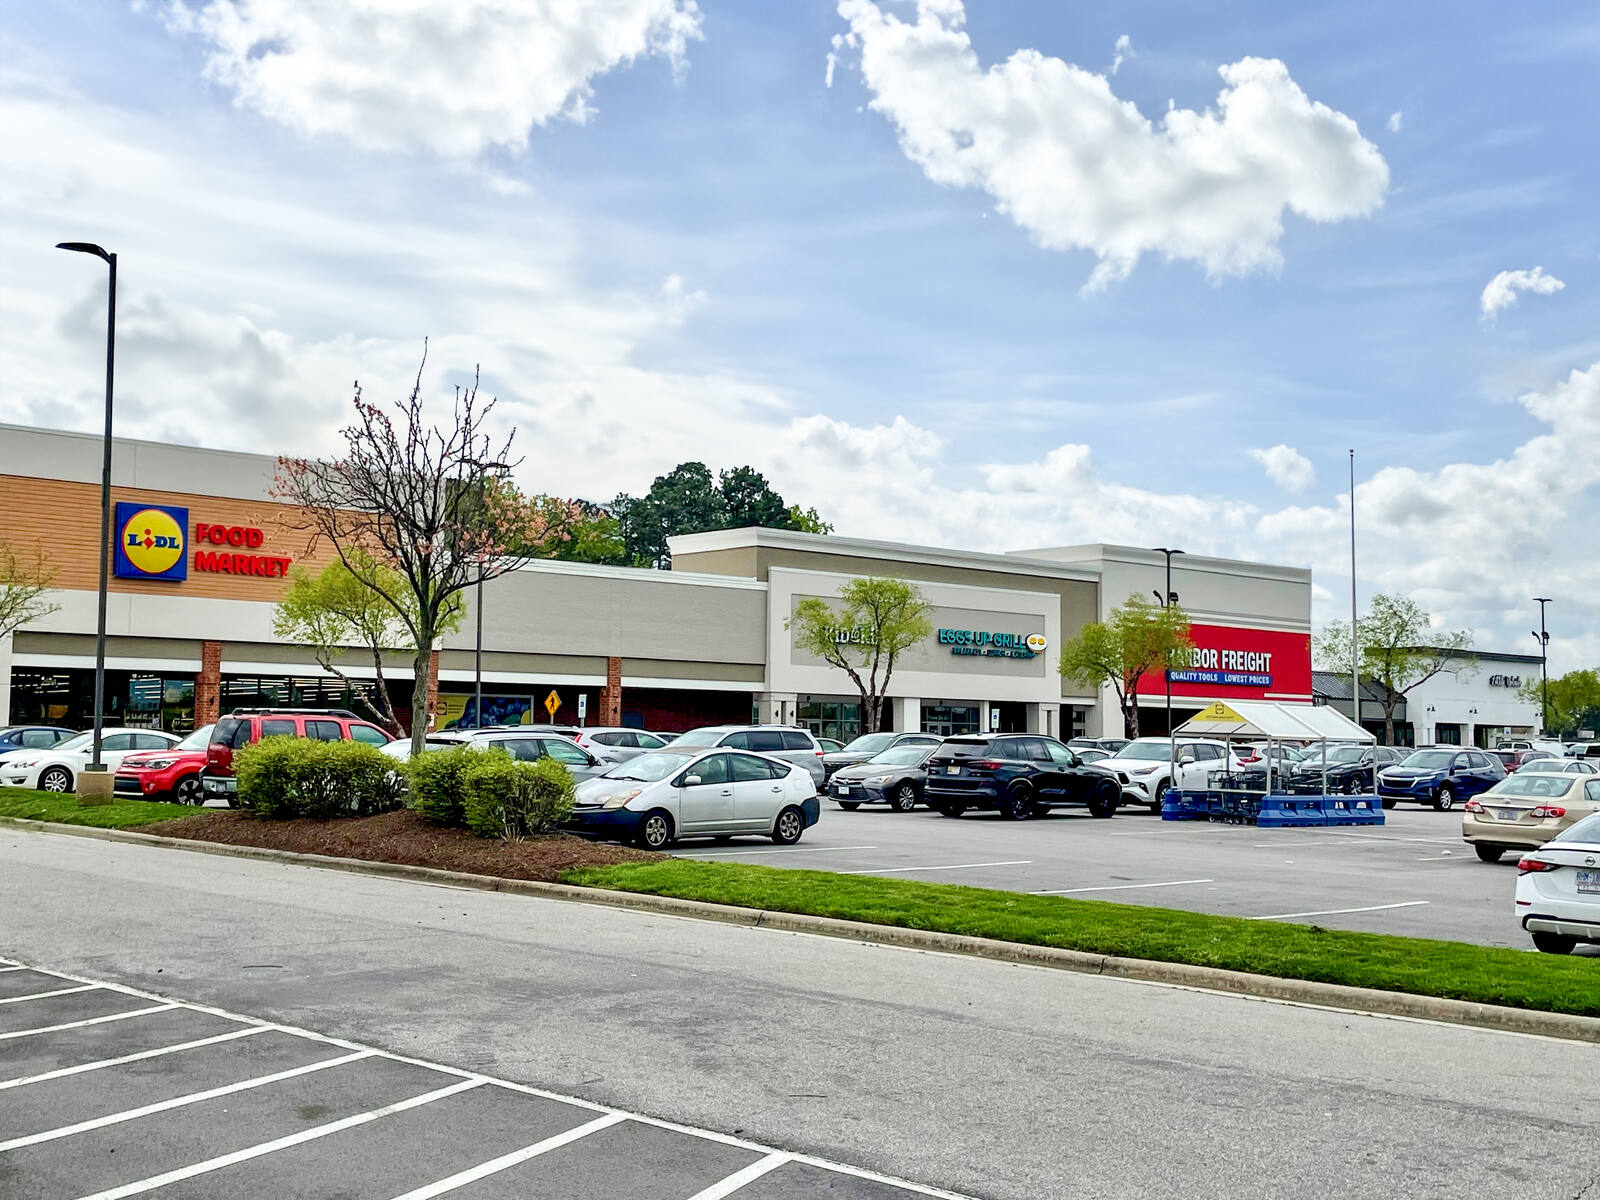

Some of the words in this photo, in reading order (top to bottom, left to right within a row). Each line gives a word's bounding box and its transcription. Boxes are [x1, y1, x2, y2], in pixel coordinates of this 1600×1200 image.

[195, 523, 264, 548] FOOD
[194, 550, 292, 577] MARKET
[939, 628, 973, 645] EGGS
[974, 631, 992, 646] UP
[993, 632, 1026, 649] GRILL
[1169, 647, 1218, 669] RBOR
[1221, 650, 1272, 672] FREIGHT
[1170, 671, 1197, 680] QUALITY
[1199, 673, 1218, 682] TOOLS
[1224, 674, 1248, 683] LOWEST
[1249, 676, 1270, 685] PRICES
